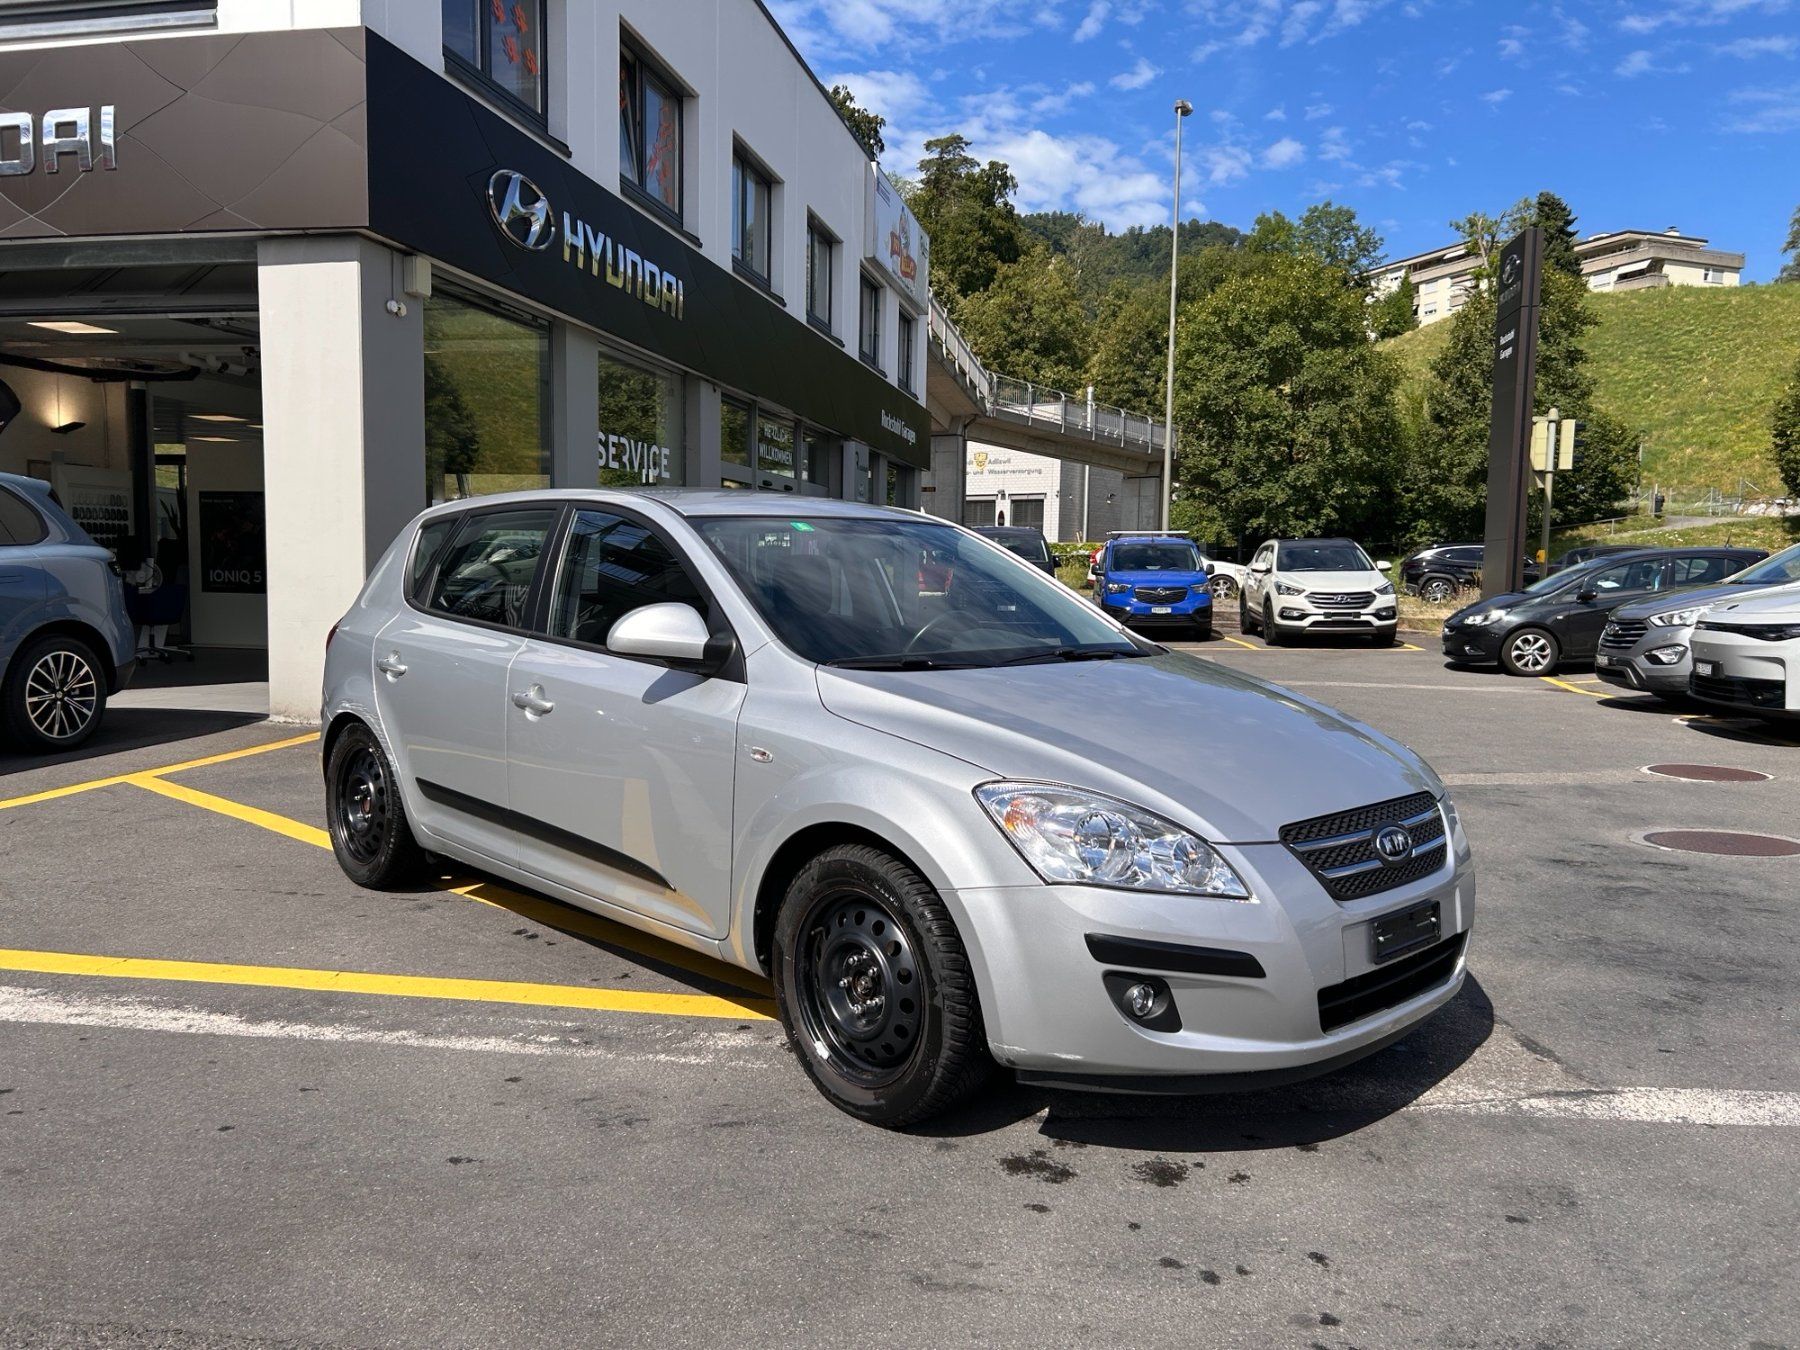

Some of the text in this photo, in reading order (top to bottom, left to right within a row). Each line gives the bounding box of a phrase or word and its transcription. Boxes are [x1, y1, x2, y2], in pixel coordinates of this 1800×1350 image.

[563, 211, 684, 321] HYUNDAI
[598, 431, 670, 479] SERVICE
[209, 569, 262, 585] IONIQ 5
